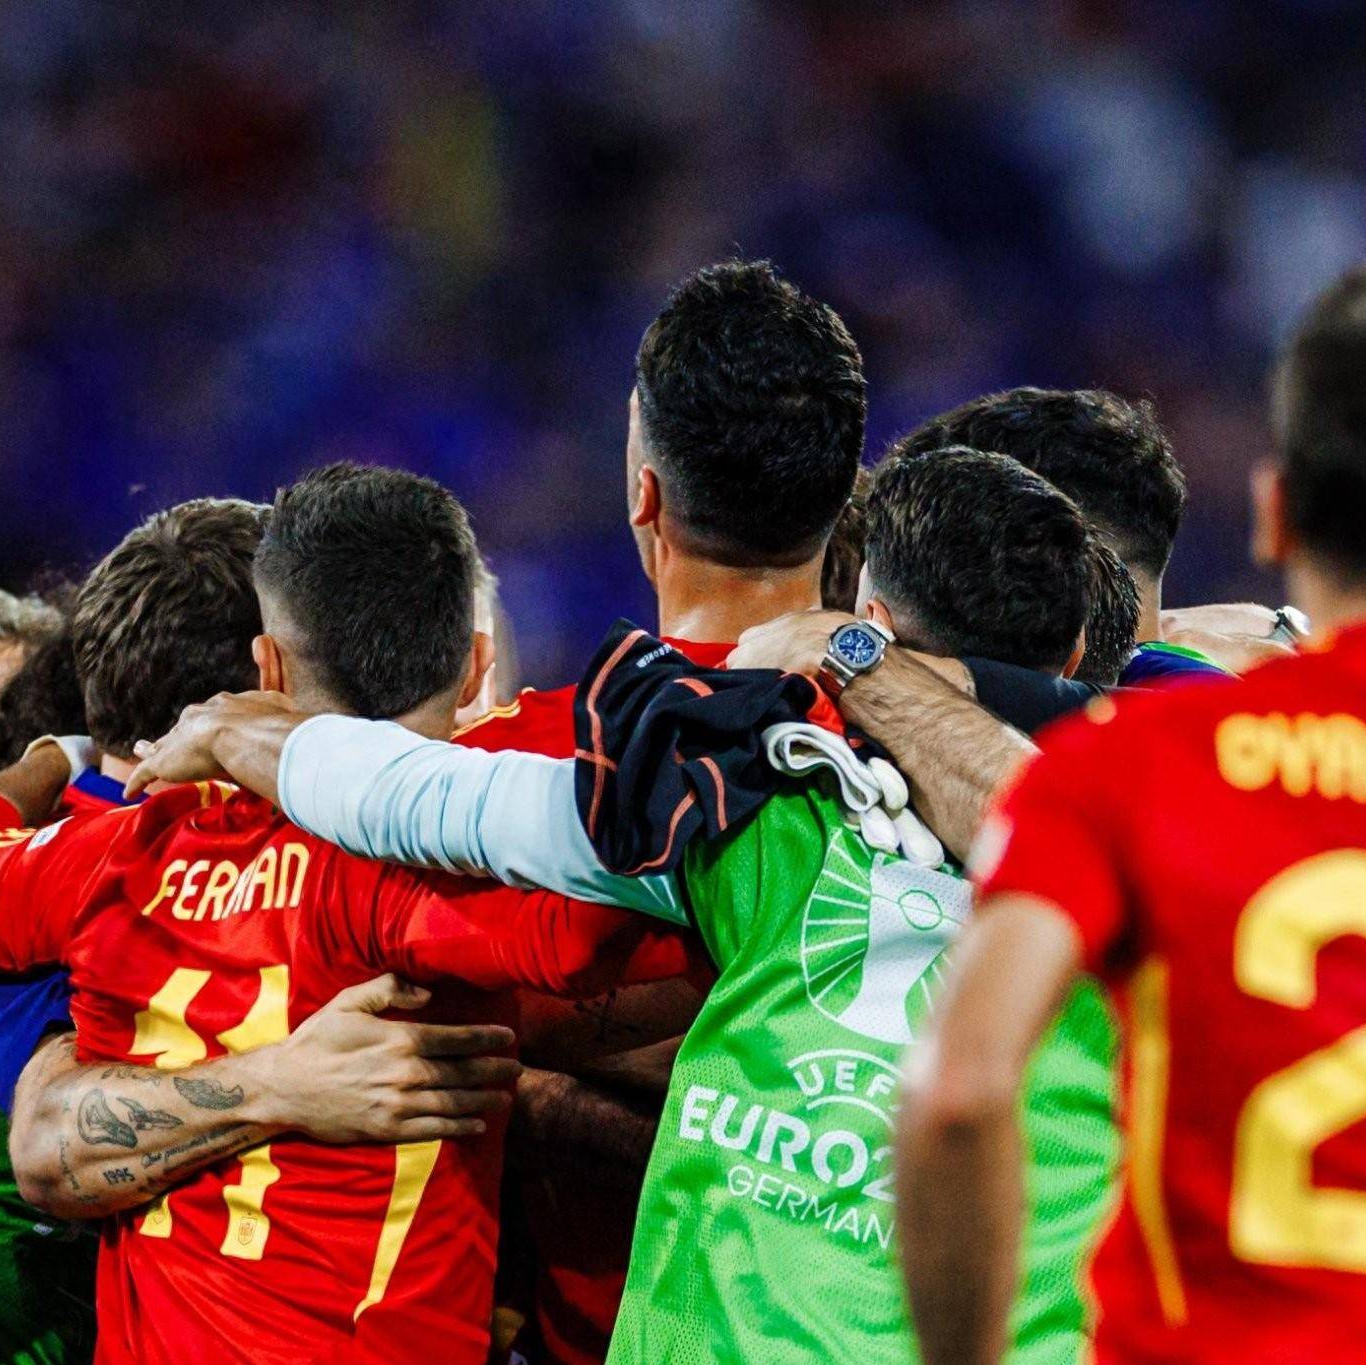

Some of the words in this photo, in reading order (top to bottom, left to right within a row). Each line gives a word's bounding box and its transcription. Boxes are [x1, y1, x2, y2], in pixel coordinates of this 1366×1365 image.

[793, 1061, 901, 1113] UEF
[679, 1084, 899, 1203] EURO2
[727, 1164, 897, 1250] GERMAN
